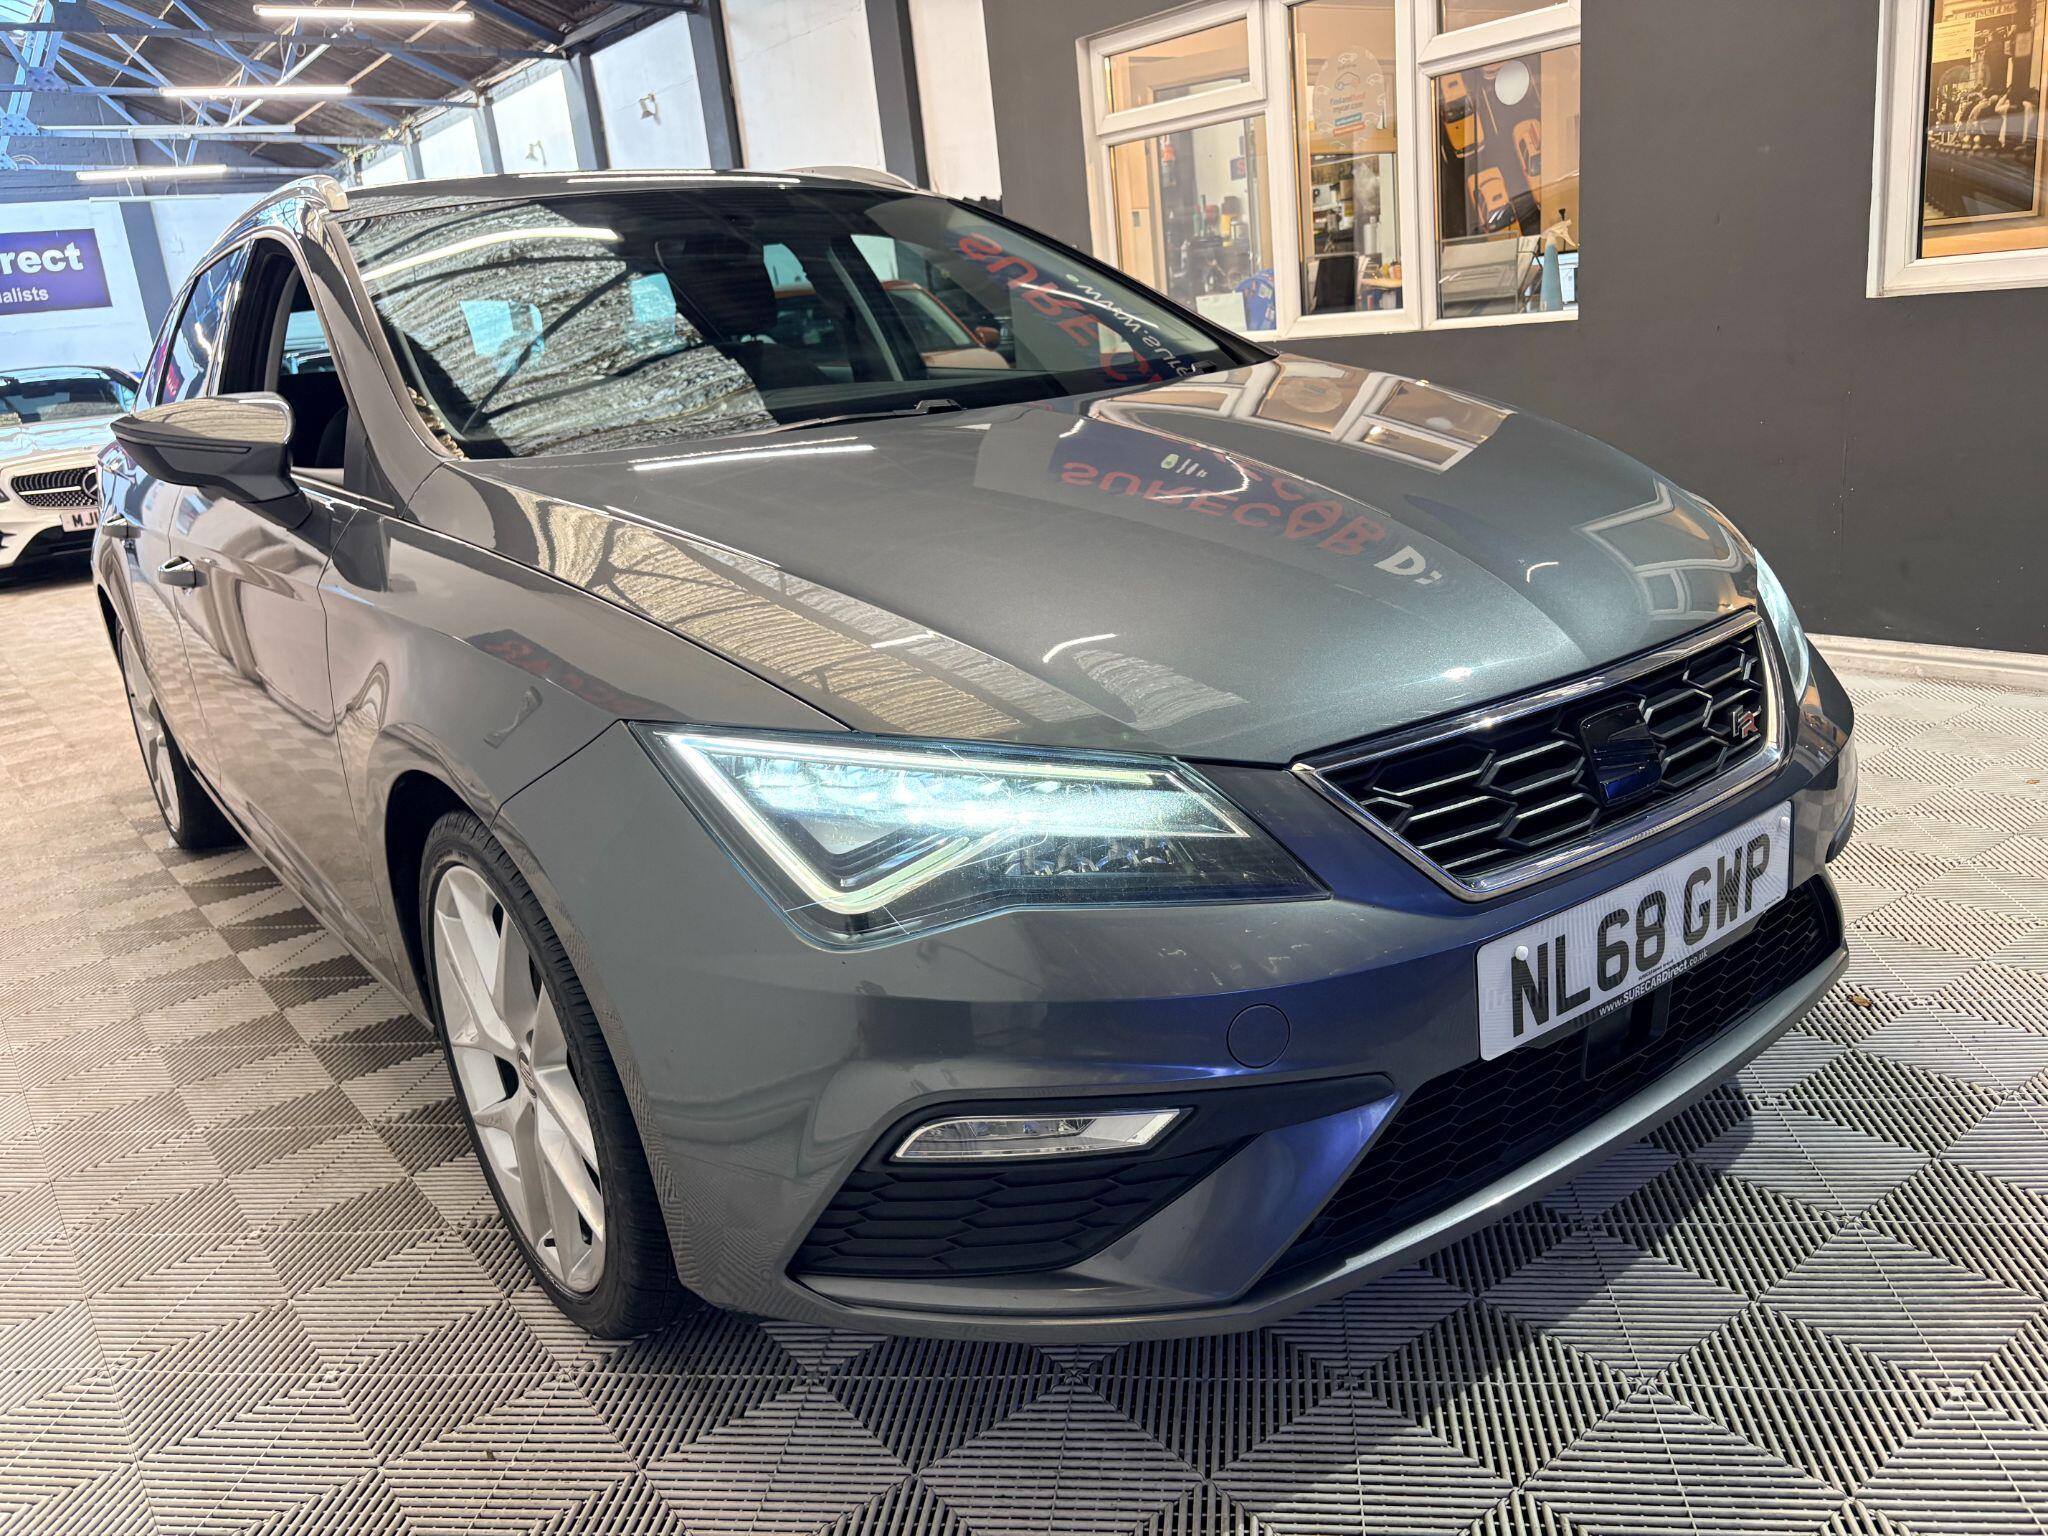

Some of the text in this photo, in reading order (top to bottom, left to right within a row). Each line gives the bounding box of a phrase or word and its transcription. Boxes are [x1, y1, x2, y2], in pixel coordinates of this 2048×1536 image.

[0, 287, 49, 304] alists
[1511, 833, 1771, 1038] NL68 GWP
[1599, 949, 1708, 1016] www.SURECARDirect.co.uk
